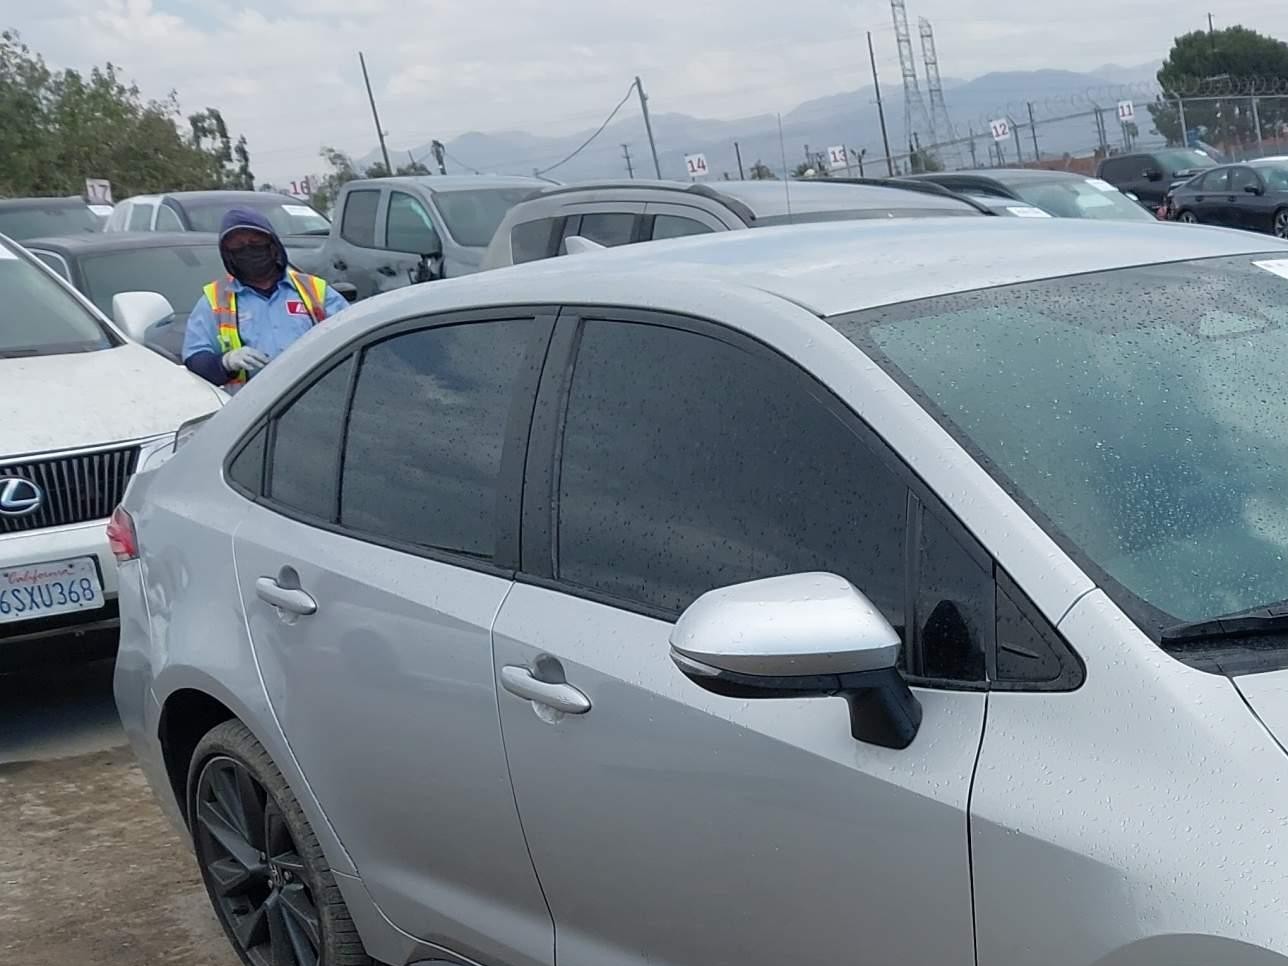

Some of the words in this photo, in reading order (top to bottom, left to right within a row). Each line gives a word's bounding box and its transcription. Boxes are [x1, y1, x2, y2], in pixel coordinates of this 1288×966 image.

[1120, 103, 1132, 117] 11
[992, 122, 1008, 137] 12
[831, 150, 847, 163] 13
[687, 157, 706, 173] 14
[89, 184, 108, 201] 17
[290, 180, 310, 195] 16
[8, 568, 75, 585] California
[0, 577, 95, 614] 6SXU368
